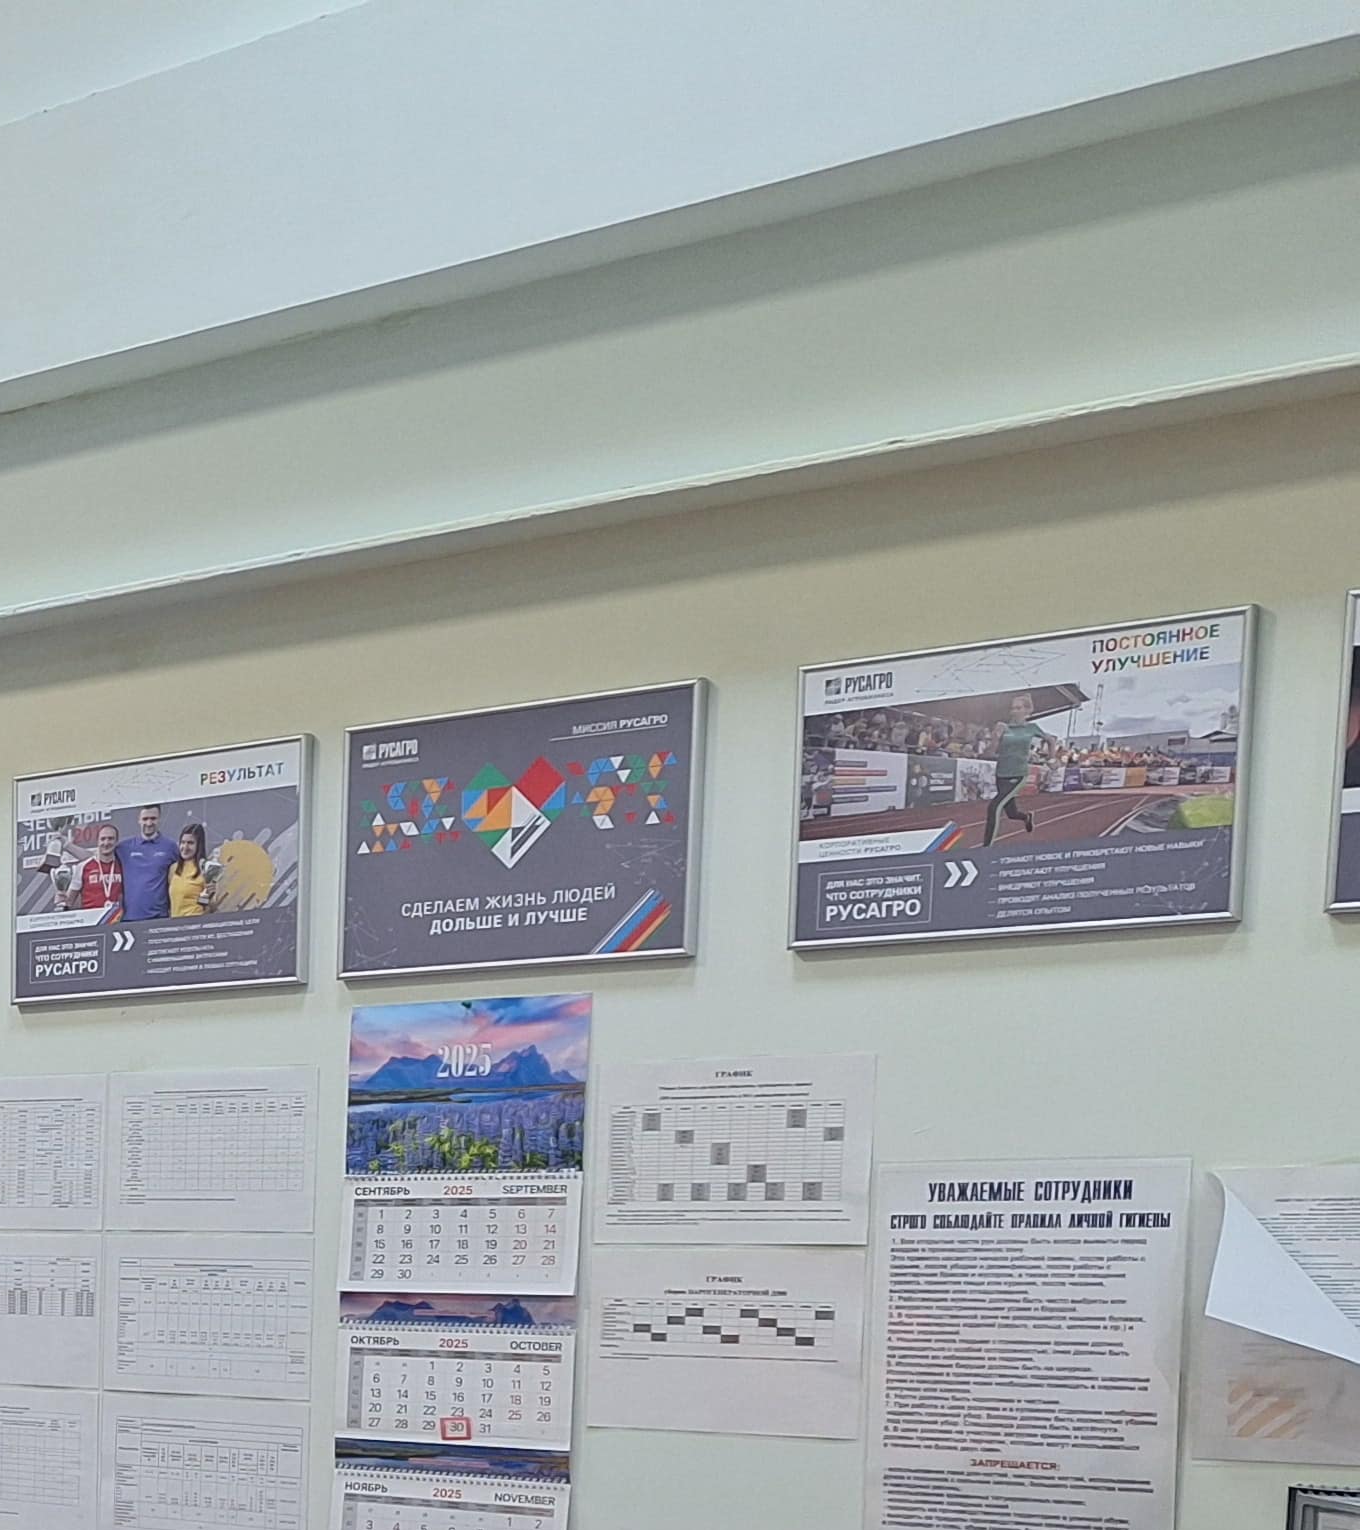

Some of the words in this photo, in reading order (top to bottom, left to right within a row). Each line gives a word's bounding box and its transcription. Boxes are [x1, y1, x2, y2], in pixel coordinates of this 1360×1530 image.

[1091, 623, 1220, 654] ПОСТОЯННОЕ
[1091, 646, 1210, 674] УЛУЧШЕНИЕ
[844, 672, 893, 694] РУСАГРО
[620, 714, 668, 728] РУСАГРО
[379, 739, 418, 759] РУСАГРО
[200, 762, 285, 785] РЕЗУЛЬТАТ
[44, 789, 76, 806] РУСАГРО
[867, 877, 883, 885] ЭТО
[401, 897, 480, 918] СДЕЛАЕМ
[484, 892, 546, 910] ЖИЗНЬ
[551, 883, 615, 905] ЛЮДЕЙ
[826, 891, 847, 901] ЧТО
[849, 886, 923, 900] СОТРУДНИКИ
[825, 899, 921, 922] РУСАГРО
[429, 913, 503, 935] ДОЛЬШЕ
[507, 913, 520, 927] И
[524, 908, 588, 926] ЛУЧШЕ
[35, 959, 98, 978] РУСАГРО
[436, 1043, 492, 1079] 2025
[354, 1186, 410, 1196] СЕНТЯБРЬ
[443, 1185, 473, 1196] 2025
[502, 1184, 568, 1195] SEPTEMBER
[928, 1181, 1025, 1202] УВАЖАЕМЫЕ
[1034, 1180, 1133, 1203] СОТРУДНИКИ
[378, 1208, 384, 1220] 1
[404, 1208, 413, 1220] 2
[432, 1208, 440, 1220] 3
[459, 1208, 468, 1220] 4
[488, 1208, 497, 1220] 5
[517, 1208, 526, 1220] 6
[547, 1207, 556, 1219] 7
[890, 1214, 927, 1230] СТРОГО
[933, 1212, 1004, 1231] СОБЛЮДАЙТЕ
[1011, 1213, 1062, 1229] ПРАВИЛА
[1068, 1211, 1113, 1228] ЛИЧНОЙ
[1119, 1212, 1171, 1228] ГИГИЕНЫ
[376, 1223, 385, 1235] 8
[403, 1223, 412, 1235] 9
[429, 1223, 442, 1235] 10
[458, 1223, 468, 1235] 11
[485, 1223, 499, 1235] 12
[514, 1223, 528, 1235] 13
[543, 1223, 557, 1235] 14
[373, 1238, 386, 1250] 15
[400, 1238, 413, 1250] 16
[428, 1238, 441, 1250] 17
[456, 1239, 469, 1251] 18
[484, 1239, 498, 1251] 19
[512, 1239, 528, 1251] 20
[543, 1239, 556, 1251] 21
[371, 1253, 386, 1265] 22
[398, 1253, 413, 1265] 23
[426, 1254, 440, 1266] 24
[453, 1254, 469, 1266] 25
[482, 1254, 498, 1266] 26
[511, 1254, 527, 1266] 27
[541, 1255, 556, 1267] 28
[370, 1268, 385, 1280] 29
[396, 1268, 412, 1280] 30
[350, 1335, 400, 1346] ОКТЯБРЬ
[439, 1338, 469, 1349] 2025
[510, 1340, 562, 1352] OCTOBER
[429, 1360, 435, 1372] 1
[455, 1361, 464, 1373] 2
[484, 1362, 493, 1374] 3
[513, 1363, 521, 1375] 4
[542, 1364, 551, 1377] 5
[372, 1372, 381, 1384] 6
[401, 1373, 408, 1385] 7
[427, 1375, 435, 1387] 8
[455, 1376, 464, 1388] 9
[481, 1377, 495, 1389] 10
[511, 1379, 521, 1391] 11
[539, 1380, 552, 1392] 12
[370, 1387, 382, 1399] 13
[397, 1388, 409, 1400] 14
[424, 1390, 437, 1402] 15
[452, 1391, 465, 1403] 16
[481, 1392, 493, 1404] 17
[509, 1394, 522, 1406] 18
[538, 1396, 552, 1408] 19
[368, 1402, 382, 1414] 20
[396, 1403, 408, 1415] 21
[423, 1404, 437, 1417] 22
[478, 1407, 493, 1419] 24
[507, 1409, 523, 1421] 25
[536, 1410, 552, 1423] 26
[367, 1416, 382, 1428] 27
[394, 1418, 409, 1430] 28
[421, 1419, 437, 1431] 29
[449, 1421, 465, 1434] 30
[478, 1423, 492, 1435] 31
[971, 1458, 1061, 1472] ЗАПРЕЩАЕТСЯ:
[344, 1481, 388, 1493] НОЯБРЬ
[433, 1488, 462, 1499] 2025
[494, 1493, 556, 1506] NOVEMBER
[365, 1519, 374, 1530] 3
[507, 1516, 513, 1528] 1
[534, 1519, 543, 1530] 2
